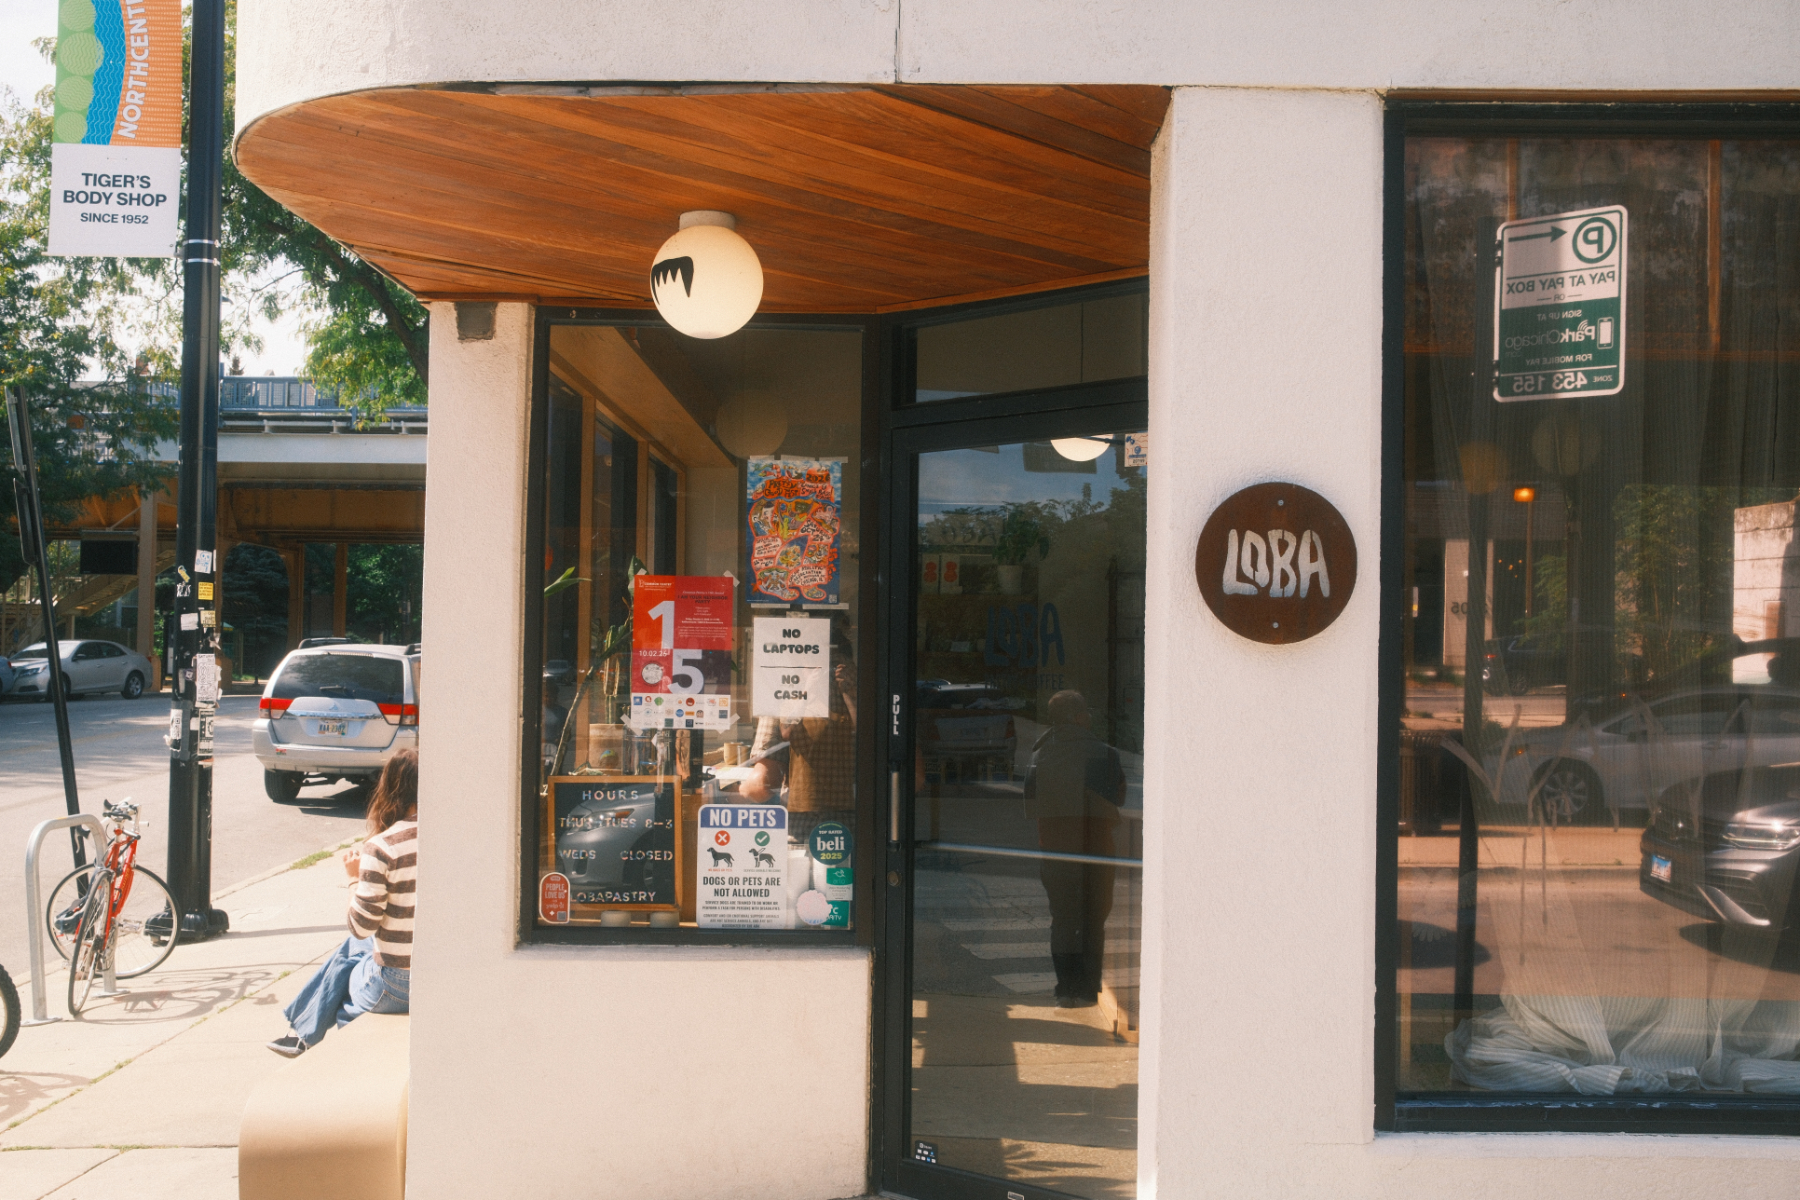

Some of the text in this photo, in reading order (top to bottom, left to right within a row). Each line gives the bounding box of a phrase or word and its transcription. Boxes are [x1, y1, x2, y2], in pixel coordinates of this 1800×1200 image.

[117, 0, 149, 139] NORTHCENT
[82, 173, 151, 188] TIGER'S
[63, 190, 167, 207] BODY SHOP
[80, 212, 149, 225] SINCE 1952
[1222, 528, 1330, 598] LOBA
[782, 629, 801, 638] NO
[984, 602, 1065, 668] LOBA
[763, 644, 820, 654] LAPTOPS
[782, 675, 800, 685] NO
[774, 690, 808, 700] CASH
[582, 790, 639, 800] HOURS
[709, 809, 776, 827] NO PETS
[816, 836, 845, 851] beli
[559, 849, 673, 861] WEDS CLOSED
[703, 876, 781, 886] DOGS OR PETS ARE
[714, 888, 770, 897] NOT ALLOWED
